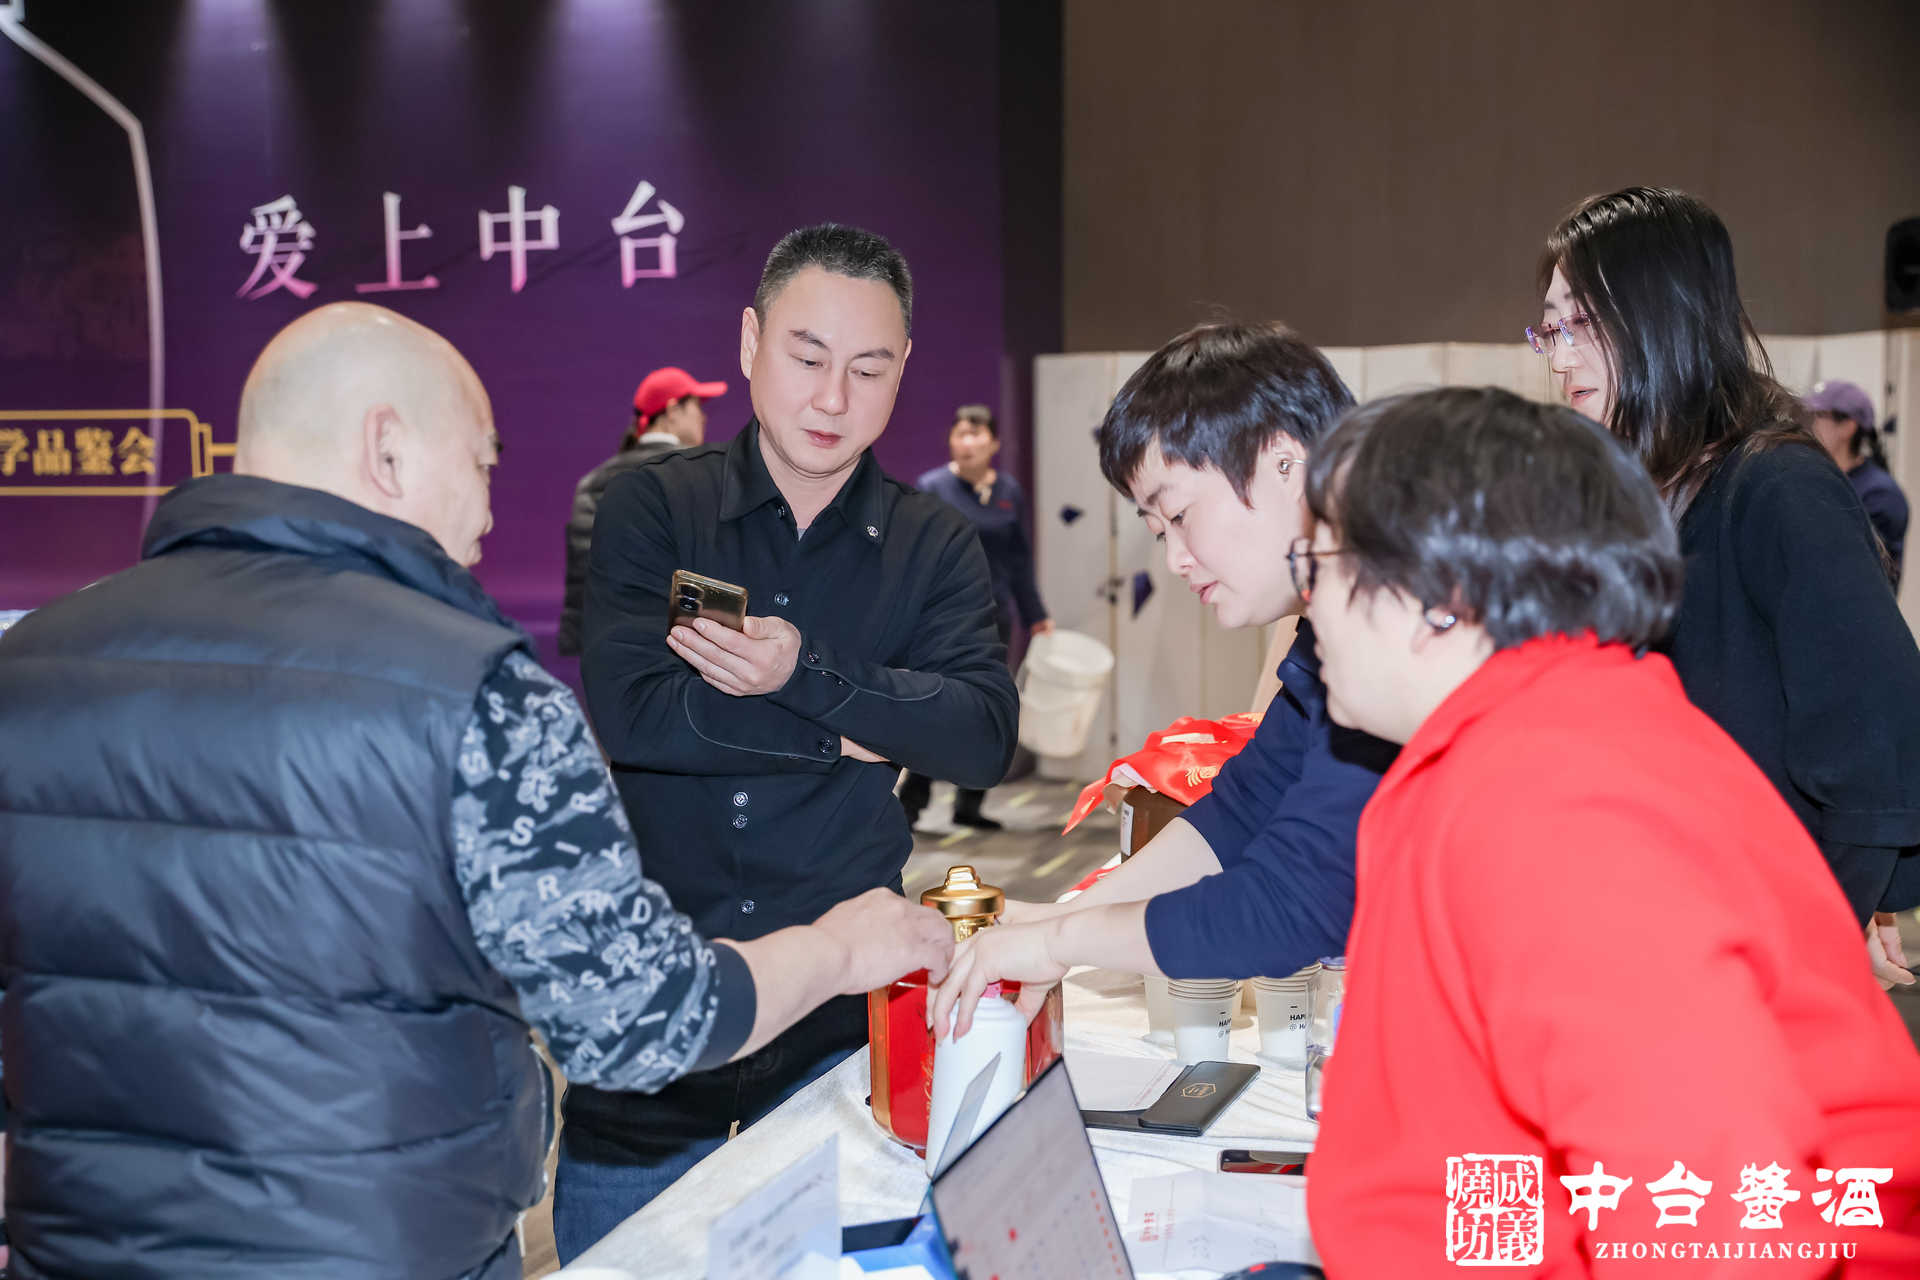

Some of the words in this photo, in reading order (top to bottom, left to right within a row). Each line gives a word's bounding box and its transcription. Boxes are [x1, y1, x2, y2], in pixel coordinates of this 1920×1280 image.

[236, 180, 685, 299] 爱上中台
[508, 815, 536, 847] S
[630, 895, 652, 925] D
